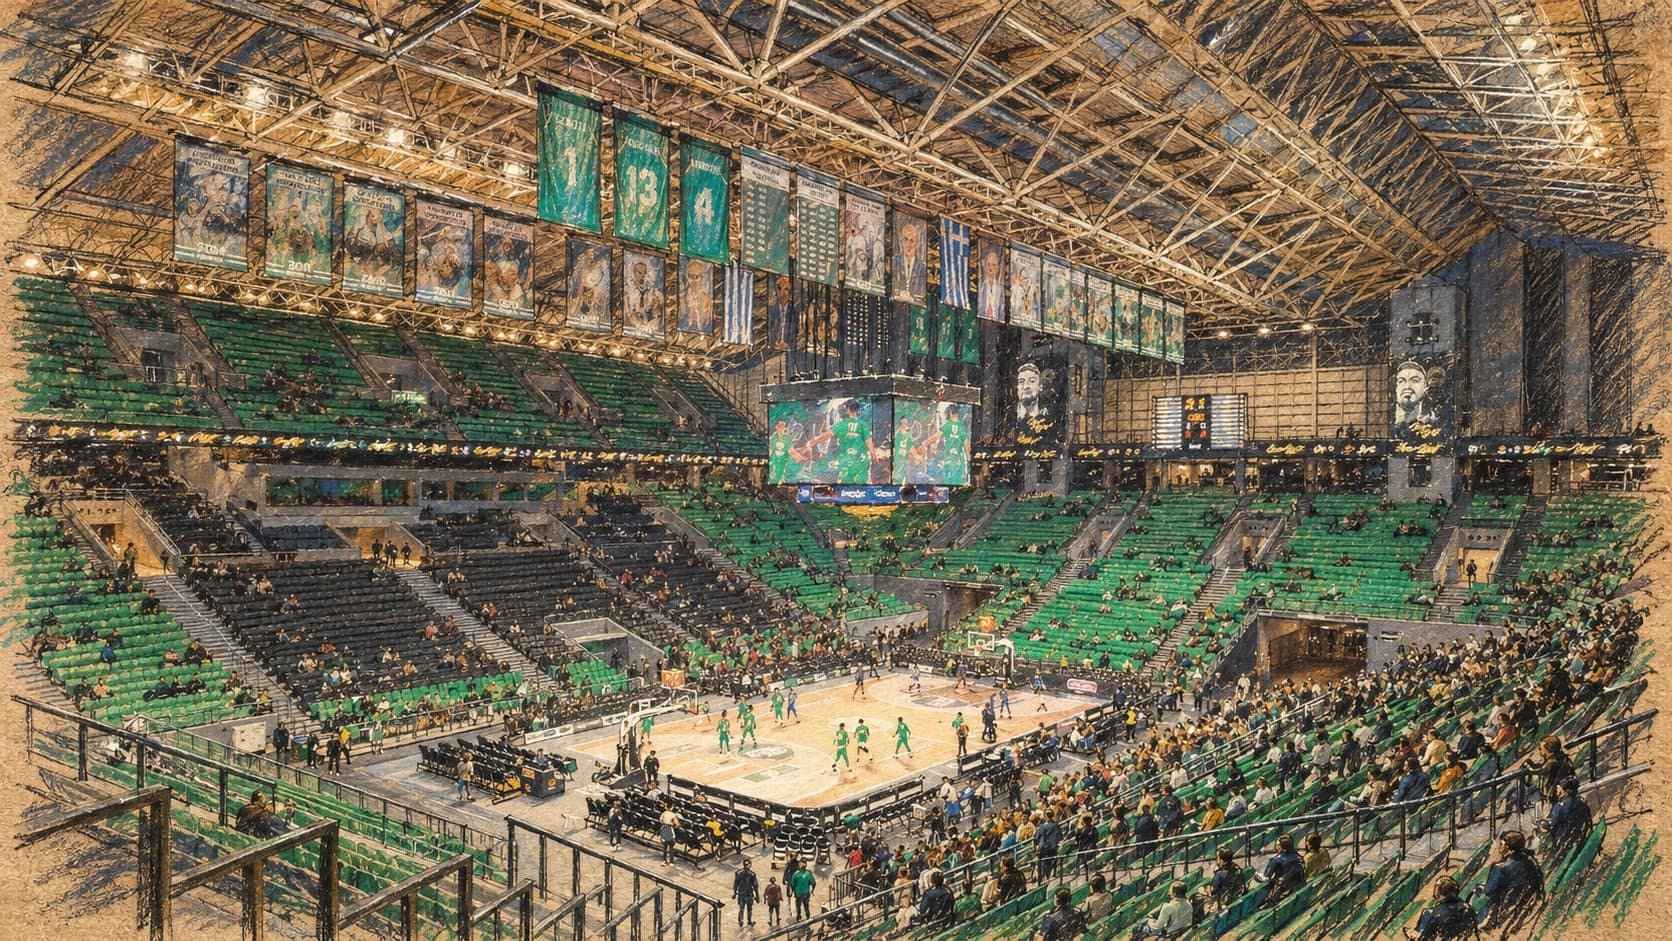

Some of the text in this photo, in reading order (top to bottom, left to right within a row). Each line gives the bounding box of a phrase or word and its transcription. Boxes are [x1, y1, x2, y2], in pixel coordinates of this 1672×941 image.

[564, 146, 577, 190] 1
[625, 164, 658, 207] 13
[693, 187, 715, 225] 4
